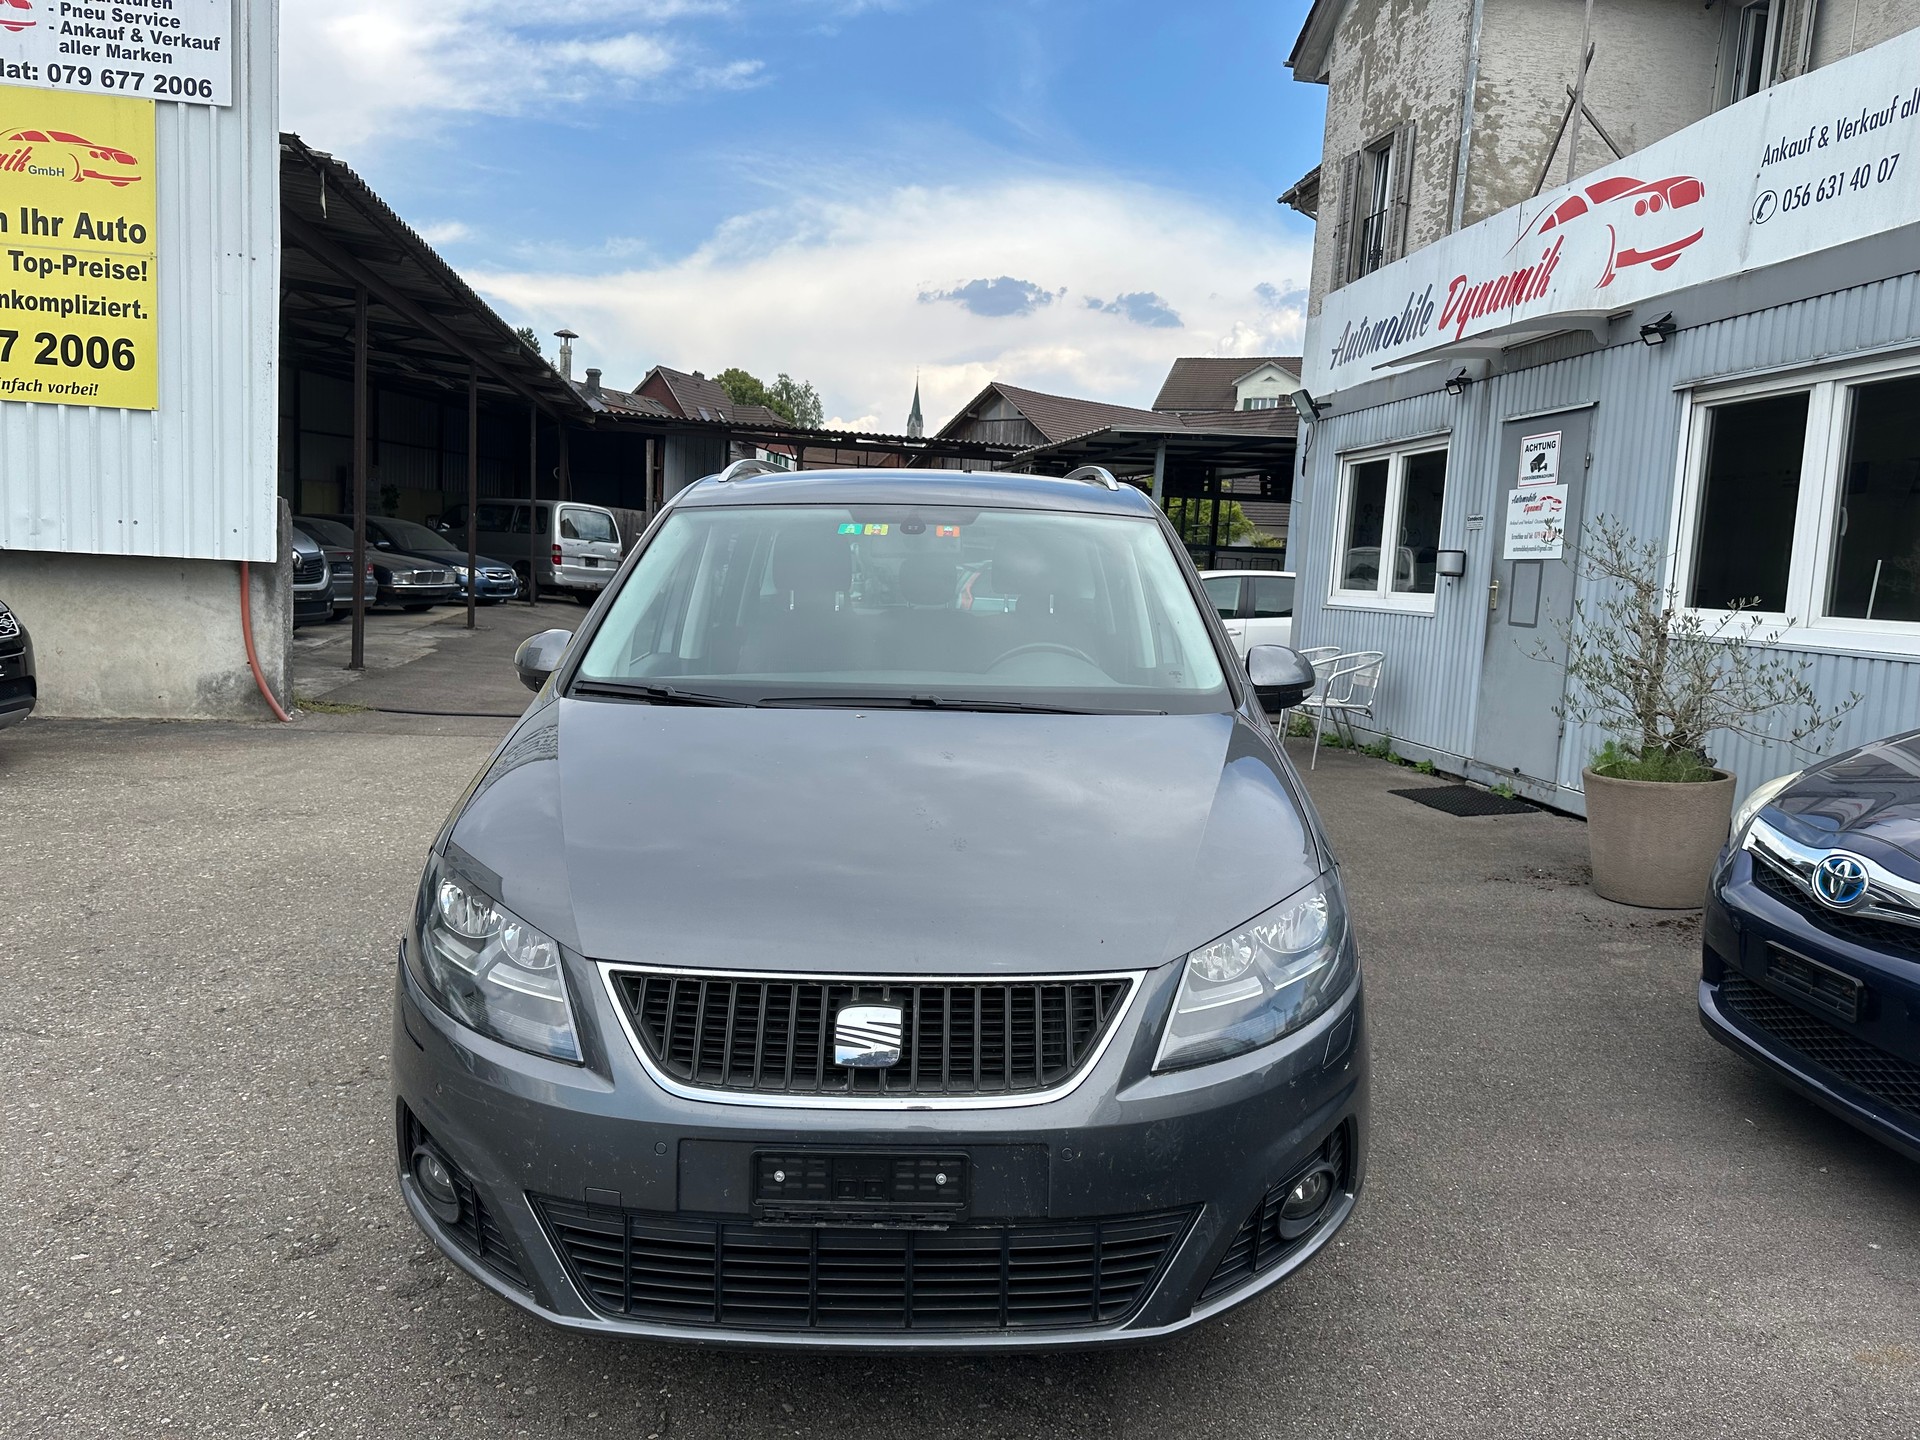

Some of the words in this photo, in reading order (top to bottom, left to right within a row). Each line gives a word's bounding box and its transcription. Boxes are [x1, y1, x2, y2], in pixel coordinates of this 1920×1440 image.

[60, 4, 105, 21] Pneu
[111, 8, 181, 29] Service
[60, 21, 125, 41] Ankauf
[130, 28, 144, 43] &
[150, 30, 221, 51] Verkauf
[58, 39, 100, 57] aller
[106, 44, 173, 64] Marken
[47, 63, 92, 86] 079
[100, 68, 145, 91] 677
[153, 73, 213, 98] 2006
[1761, 126, 1816, 168] Ankauf
[1817, 125, 1829, 148] &
[1836, 95, 1900, 142] Verkauf
[28, 164, 65, 177] GmbH
[1782, 183, 1811, 212] 056
[1816, 171, 1845, 202] 631
[1850, 163, 1871, 191] 40
[1877, 153, 1901, 183] 07
[20, 207, 64, 237] Ihr
[73, 212, 147, 244] Auto
[8, 249, 148, 282] Top-Preise!
[1330, 283, 1435, 370] Automobile
[1438, 235, 1565, 341] Dynamik
[34, 331, 136, 371] 2006
[0, 377, 42, 394] nfach
[48, 381, 99, 397] vorbei!
[1525, 440, 1557, 453] ACHTUNG
[1511, 493, 1537, 504] Automobile
[1523, 502, 1544, 515] Dynamik
